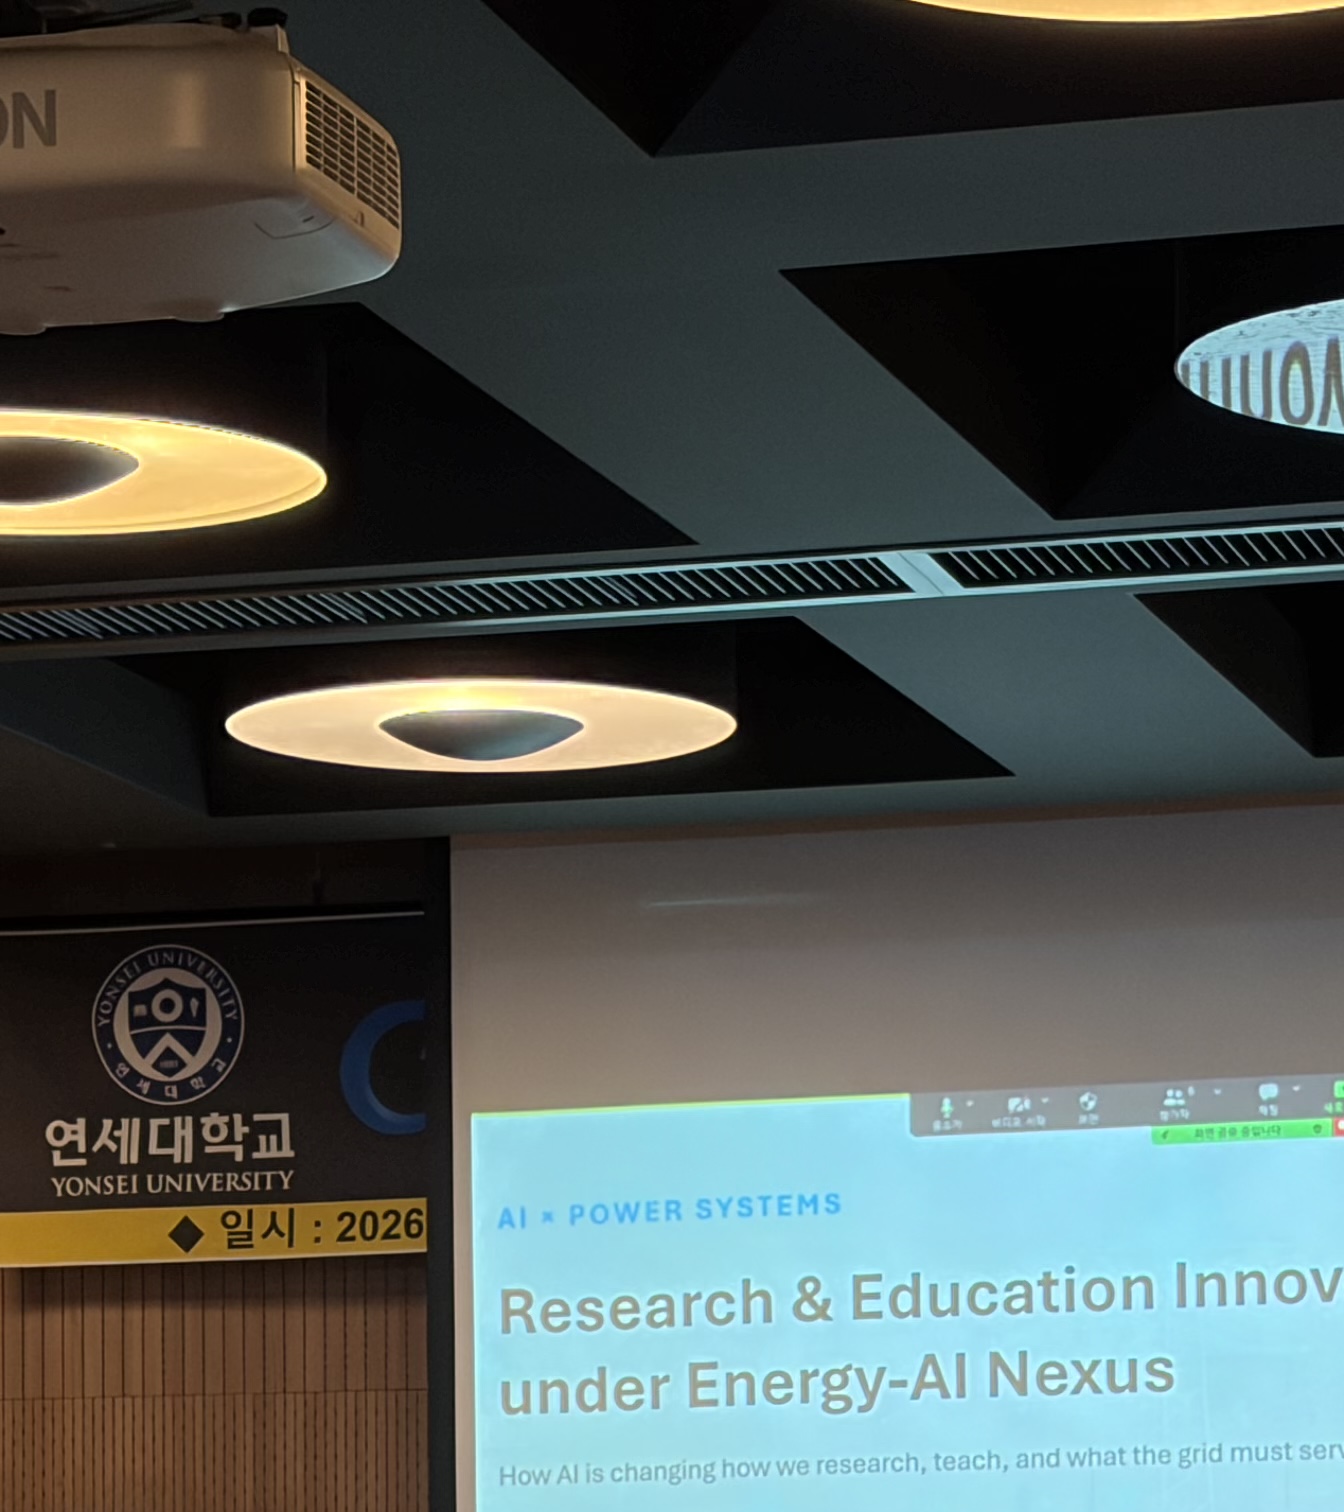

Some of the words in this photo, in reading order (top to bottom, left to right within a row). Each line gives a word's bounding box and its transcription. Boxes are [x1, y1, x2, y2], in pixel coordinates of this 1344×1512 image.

[98, 961, 141, 1027] YONSEI
[45, 1112, 295, 1167] 연세대학교
[51, 1174, 139, 1197] YONSEI
[146, 1170, 295, 1194] UNIVERSITY
[220, 1208, 296, 1250] 일시
[336, 1208, 424, 1244] 2026
[497, 1206, 527, 1230] AI
[570, 1198, 684, 1226] POWER
[695, 1192, 842, 1220] SYSTEMS
[500, 1278, 774, 1334] Research
[792, 1275, 834, 1322] &
[852, 1264, 1155, 1321] Education
[500, 1366, 671, 1416] under
[688, 1352, 967, 1416] Energy-AI
[989, 1350, 1175, 1398] Nexus
[499, 1464, 551, 1488] How
[557, 1463, 580, 1486] AI
[585, 1462, 605, 1484] is
[610, 1457, 716, 1486] changing
[721, 1456, 771, 1479] how
[776, 1458, 810, 1478] we
[816, 1450, 927, 1477] research,
[933, 1448, 1009, 1474] teach,
[1016, 1447, 1061, 1470] and
[1067, 1446, 1127, 1469] what
[1133, 1444, 1172, 1467] the
[1178, 1441, 1223, 1470] grid
[1230, 1441, 1293, 1464] must
